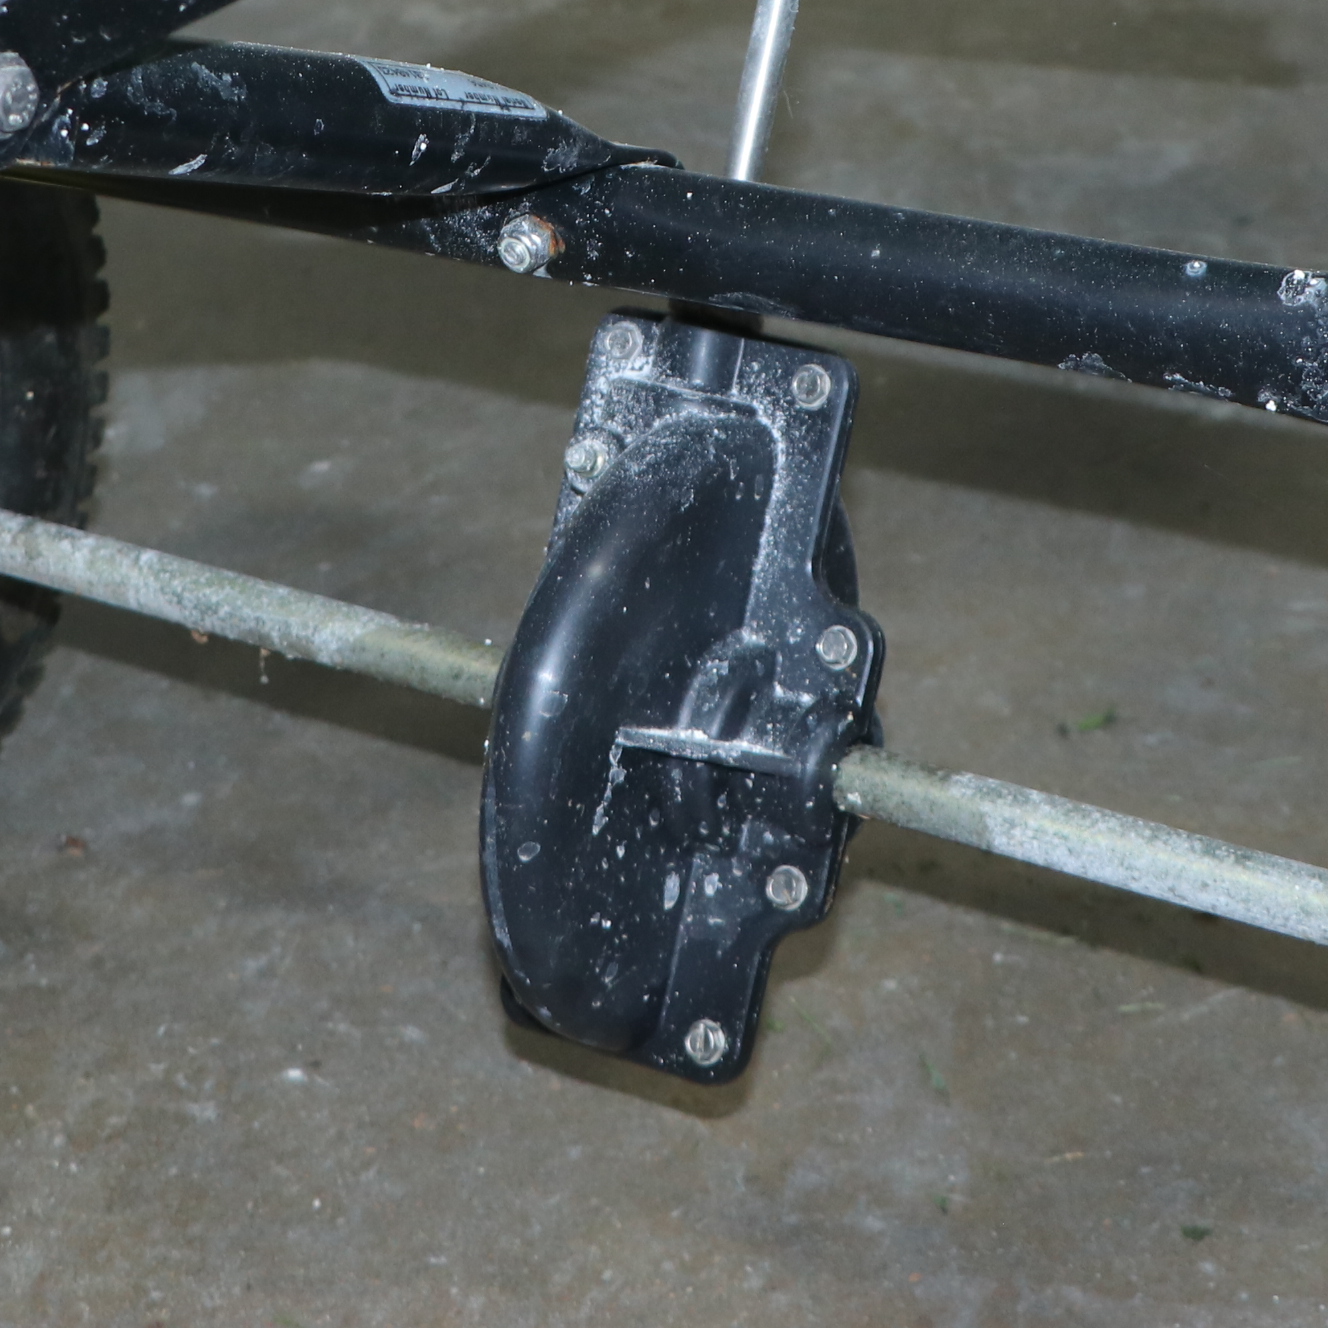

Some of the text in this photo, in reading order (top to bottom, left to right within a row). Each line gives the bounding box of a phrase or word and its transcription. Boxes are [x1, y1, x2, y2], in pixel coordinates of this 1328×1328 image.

[396, 84, 450, 99] Lot Number
[465, 91, 501, 106] Number
